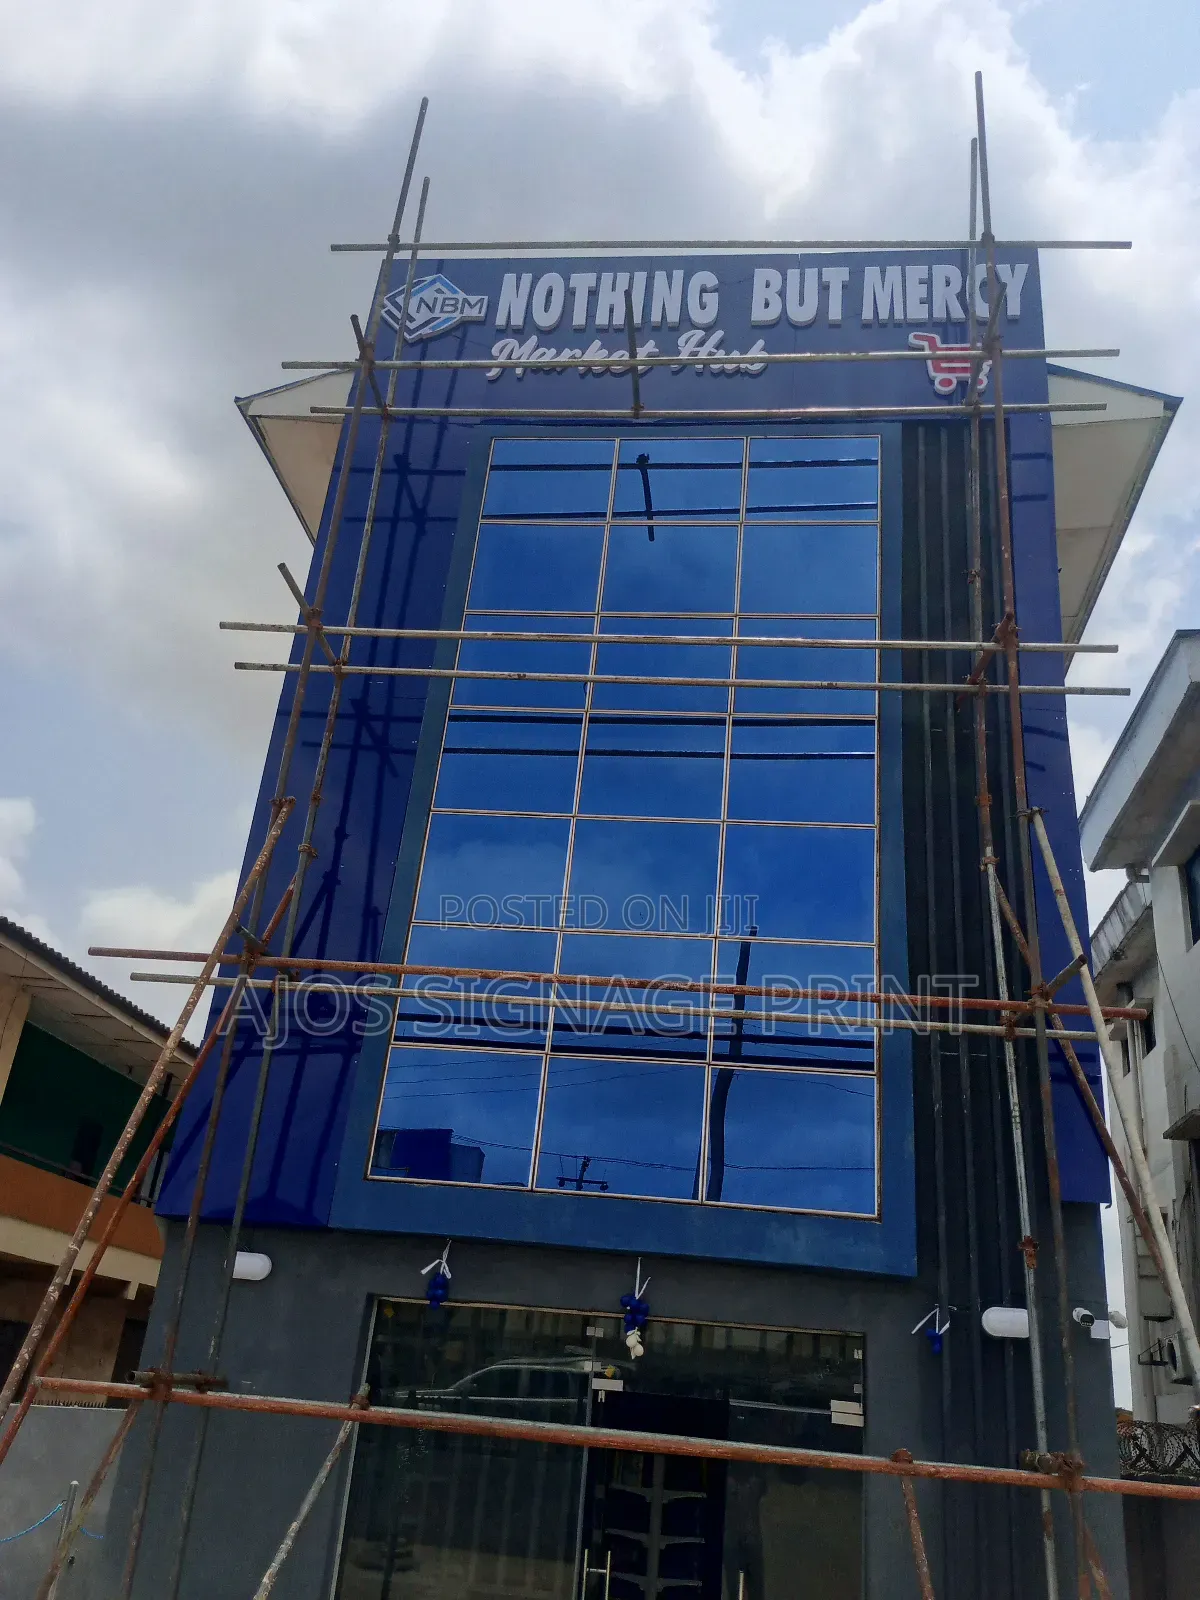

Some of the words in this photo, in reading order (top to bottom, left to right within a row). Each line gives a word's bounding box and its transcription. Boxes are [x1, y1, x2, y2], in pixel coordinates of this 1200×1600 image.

[416, 295, 485, 315] NBM
[495, 270, 719, 331] NOTHING
[751, 267, 849, 326] BUT
[485, 335, 660, 381] Market
[677, 329, 770, 375] Hub
